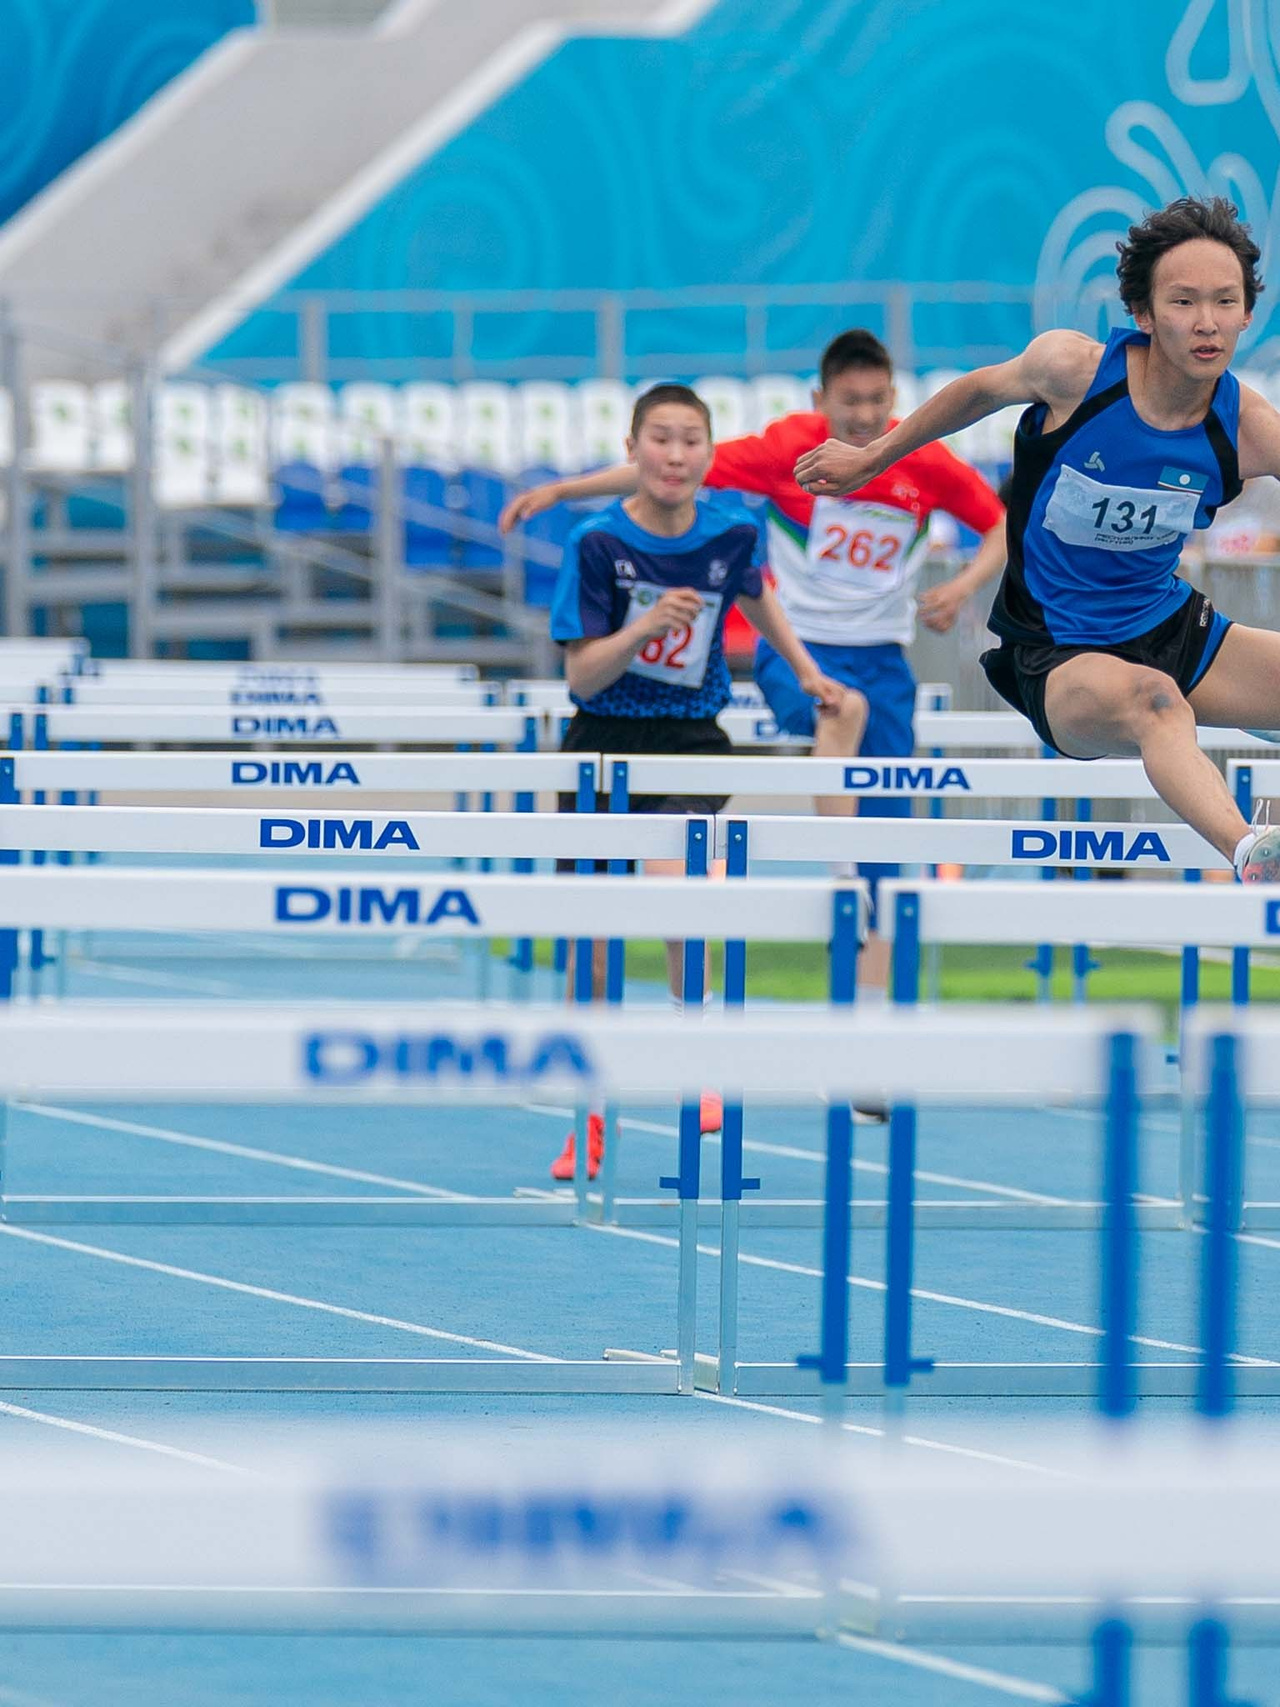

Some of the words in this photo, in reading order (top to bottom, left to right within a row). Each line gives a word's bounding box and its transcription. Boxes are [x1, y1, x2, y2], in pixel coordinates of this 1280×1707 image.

[1092, 497, 1157, 534] 131
[818, 523, 901, 573] 262
[231, 717, 339, 739] DIMA
[231, 762, 360, 785] DIMA
[843, 767, 970, 790] DIMA
[260, 818, 420, 850] DIMA
[1012, 830, 1170, 861] DIMA
[274, 886, 480, 926] DIMA
[302, 1030, 596, 1086] DIMA
